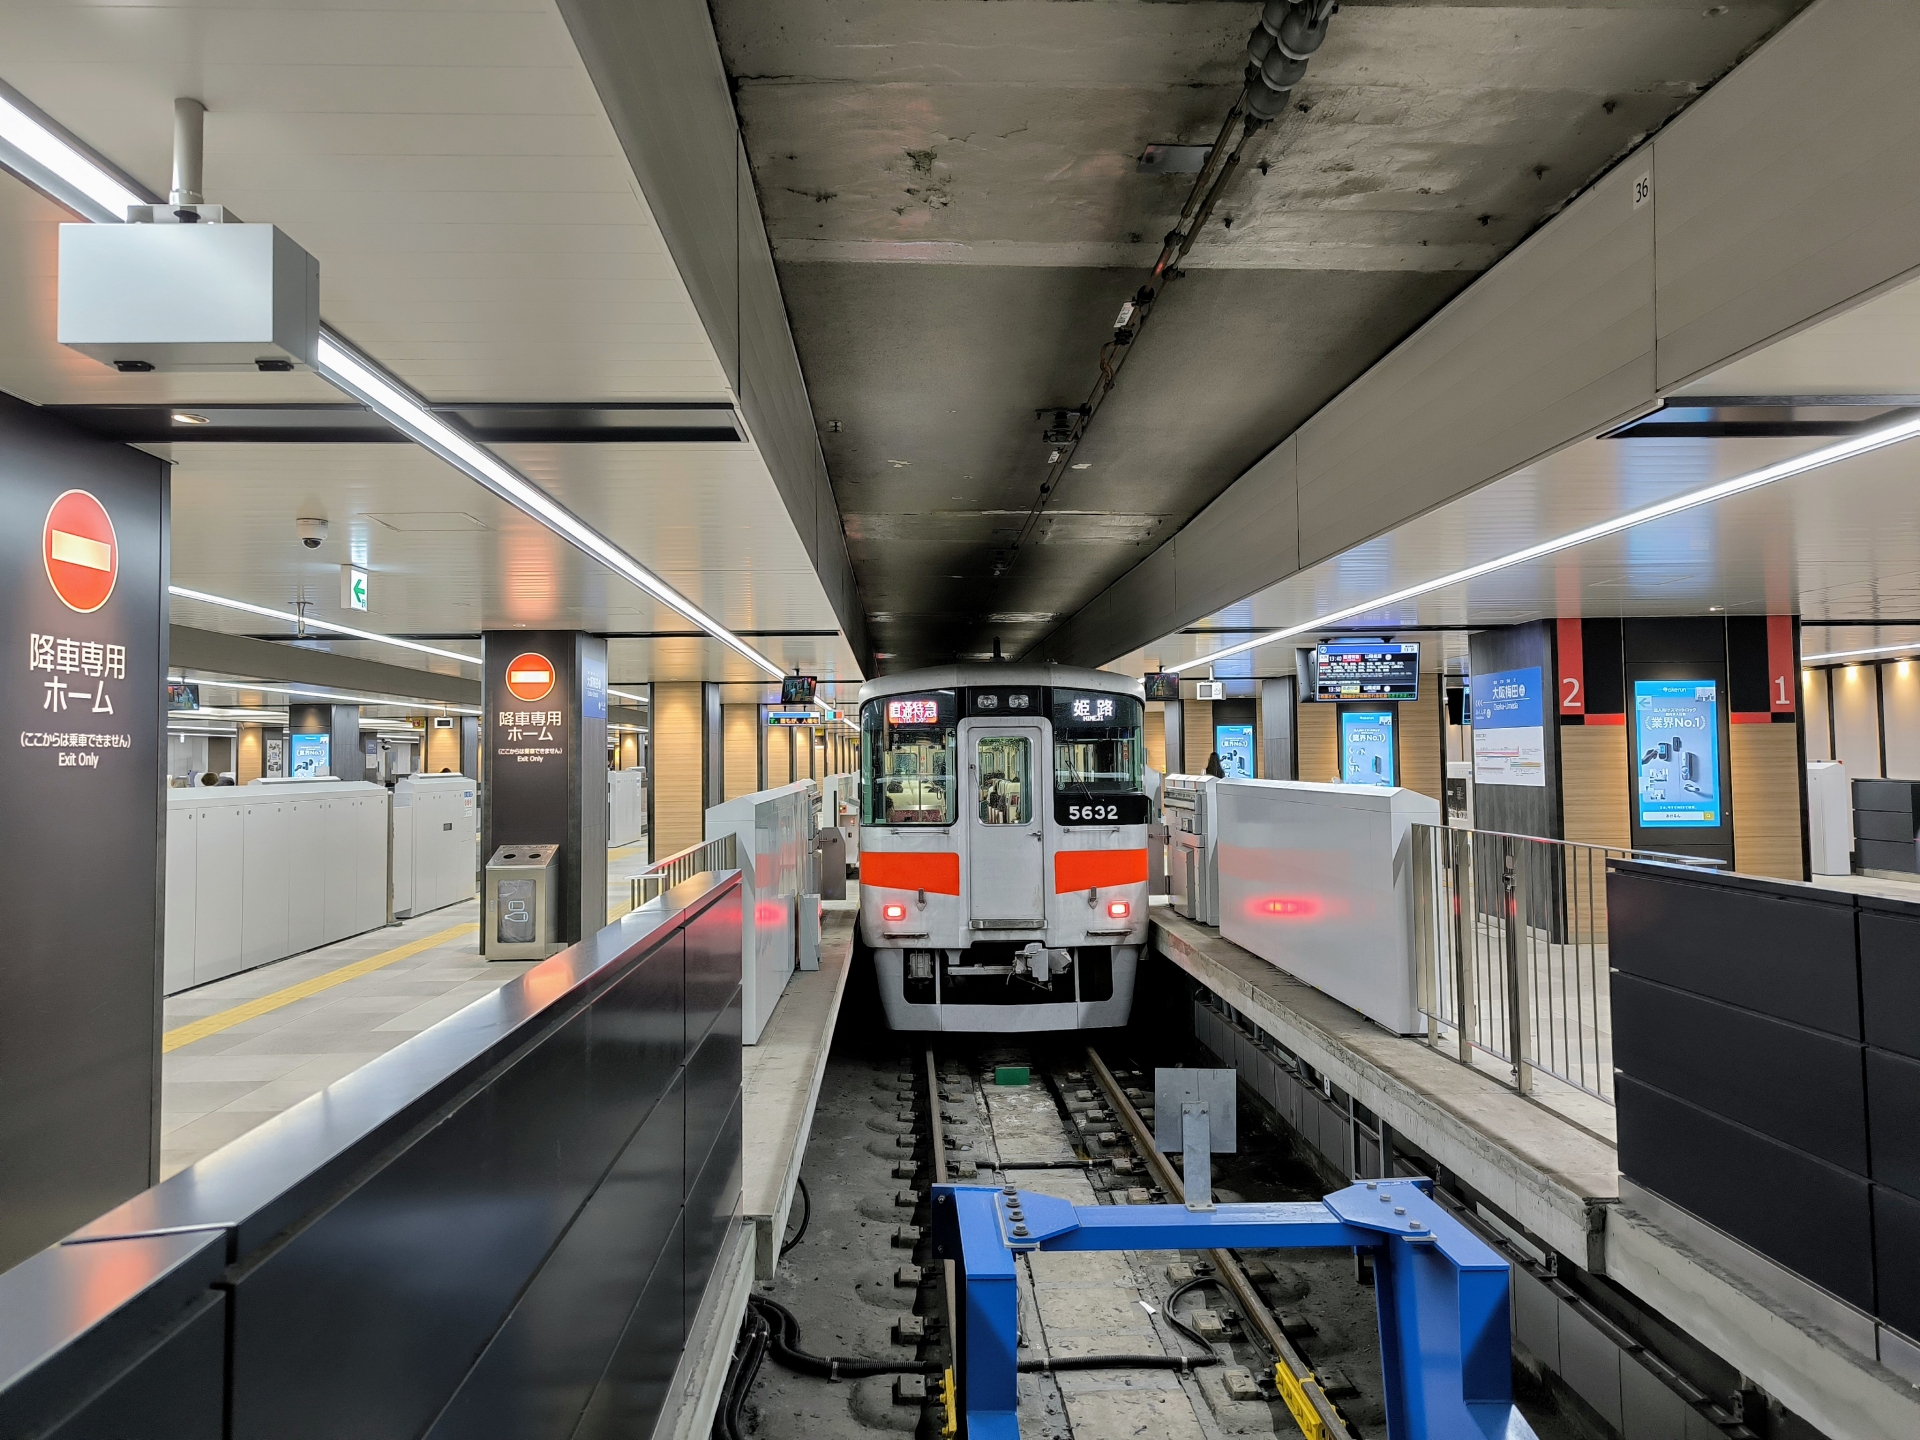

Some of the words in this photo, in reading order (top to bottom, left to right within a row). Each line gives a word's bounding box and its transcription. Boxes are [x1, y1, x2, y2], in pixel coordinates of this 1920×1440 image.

[1636, 178, 1648, 203] 36
[30, 633, 126, 680] 降車専用
[43, 676, 114, 715] ホーム
[1492, 684, 1518, 700] 大阪梅田
[1562, 677, 1582, 707] 2
[1775, 675, 1790, 705] 1
[890, 701, 937, 718] 直通特急
[1073, 699, 1113, 716] 姫路
[499, 711, 562, 727] 降車専用
[1651, 716, 1700, 729] 業界No.1
[20, 731, 131, 748] (ここからは乗車できません)
[507, 726, 554, 742] ホーム
[58, 752, 77, 767] Exit
[78, 752, 99, 768] Only
[529, 755, 544, 763] Only
[1069, 805, 1118, 820] 5632
